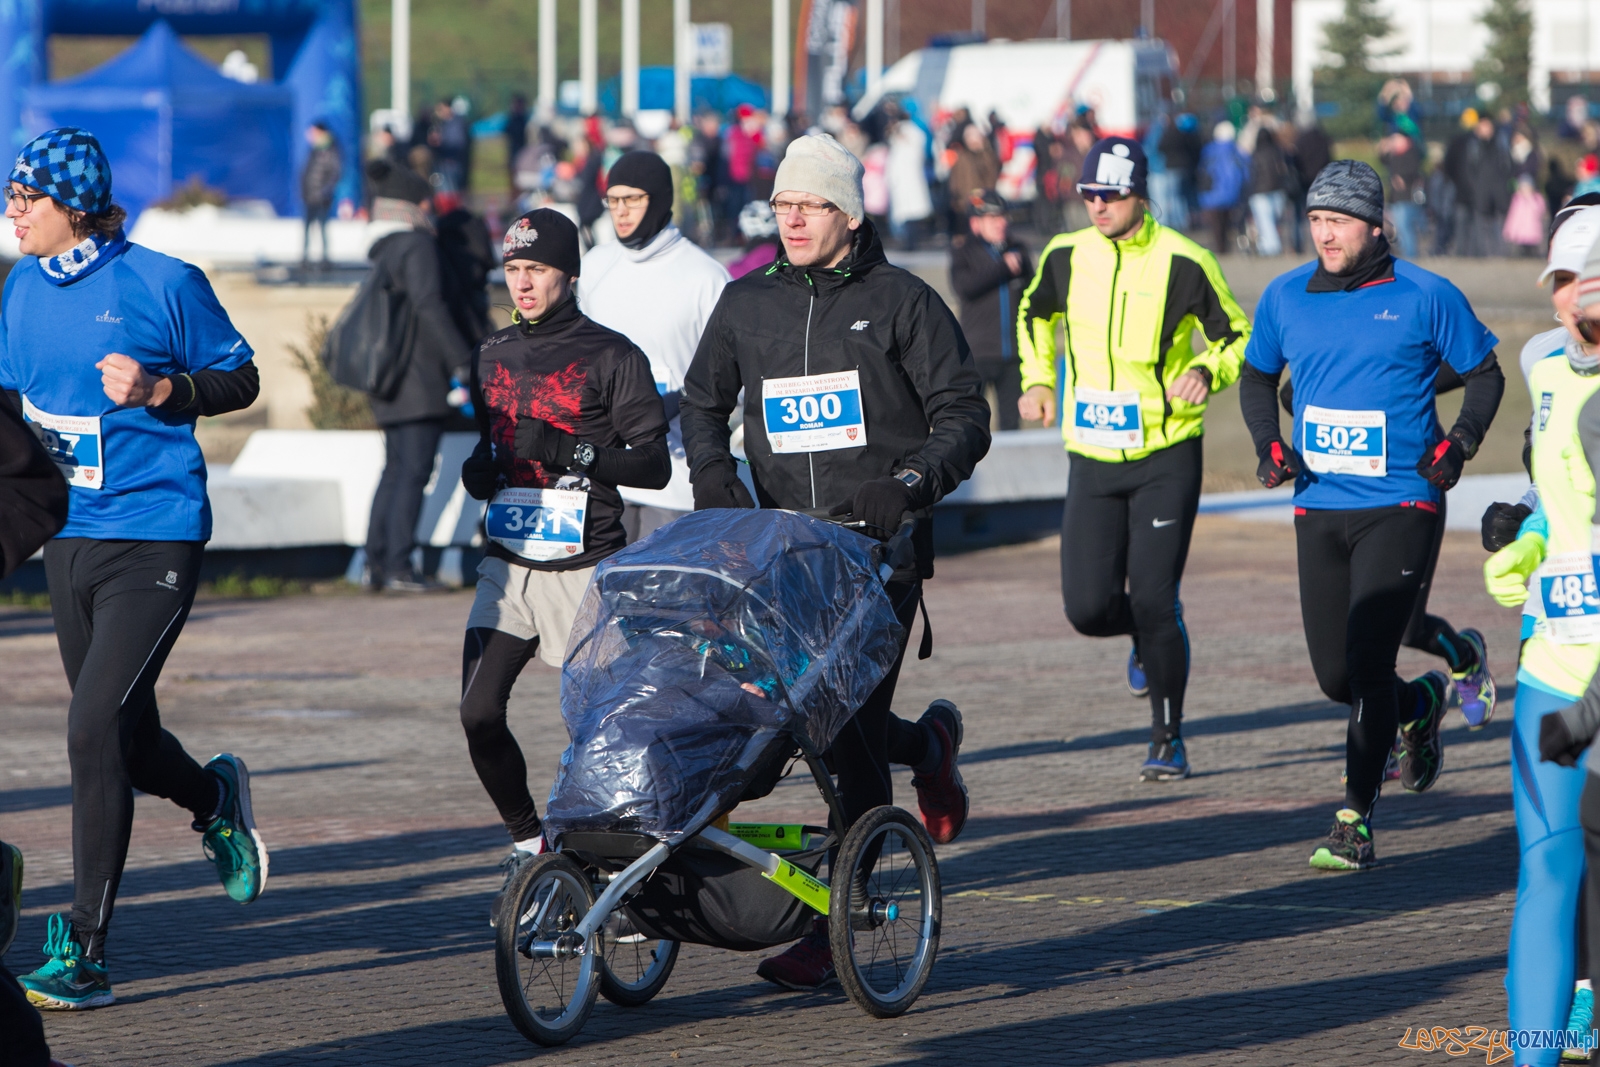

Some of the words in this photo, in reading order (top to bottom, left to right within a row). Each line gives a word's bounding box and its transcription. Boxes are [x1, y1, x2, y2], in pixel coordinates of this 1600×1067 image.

[850, 320, 870, 331] 4F
[785, 387, 815, 395] RYSZARDA
[816, 383, 849, 392] BURGIELA
[801, 376, 851, 387] SYLWESTROWY
[780, 393, 842, 424] 300
[1082, 403, 1128, 427] 494
[799, 421, 824, 430] ROMAN
[1315, 424, 1369, 451] 502
[38, 426, 80, 457] 97
[504, 506, 562, 535] 341
[1549, 574, 1600, 608] 485
